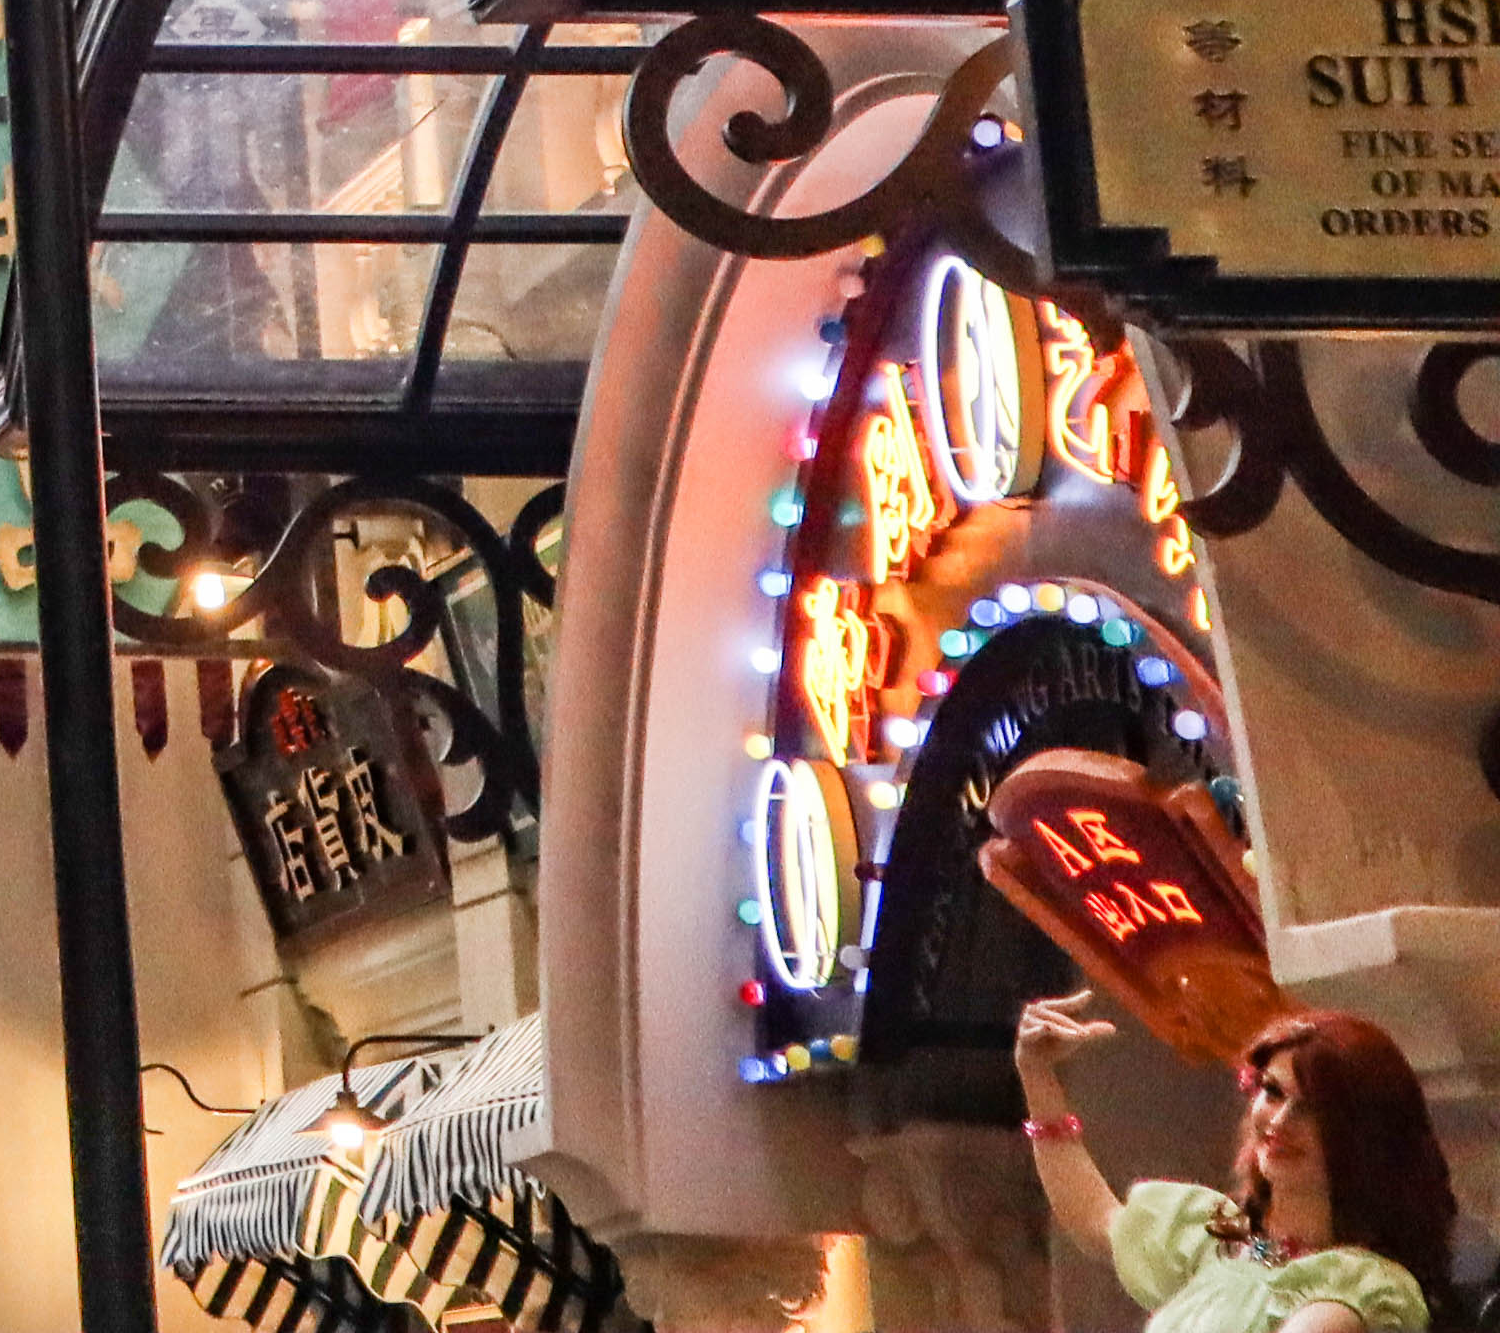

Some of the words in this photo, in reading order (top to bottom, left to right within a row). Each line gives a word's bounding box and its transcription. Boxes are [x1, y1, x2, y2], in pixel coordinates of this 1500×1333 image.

[1307, 54, 1479, 108] SUIT
[1340, 130, 1435, 160] FINE
[1370, 169, 1427, 199] OF
[1321, 208, 1490, 239] ORDERS
